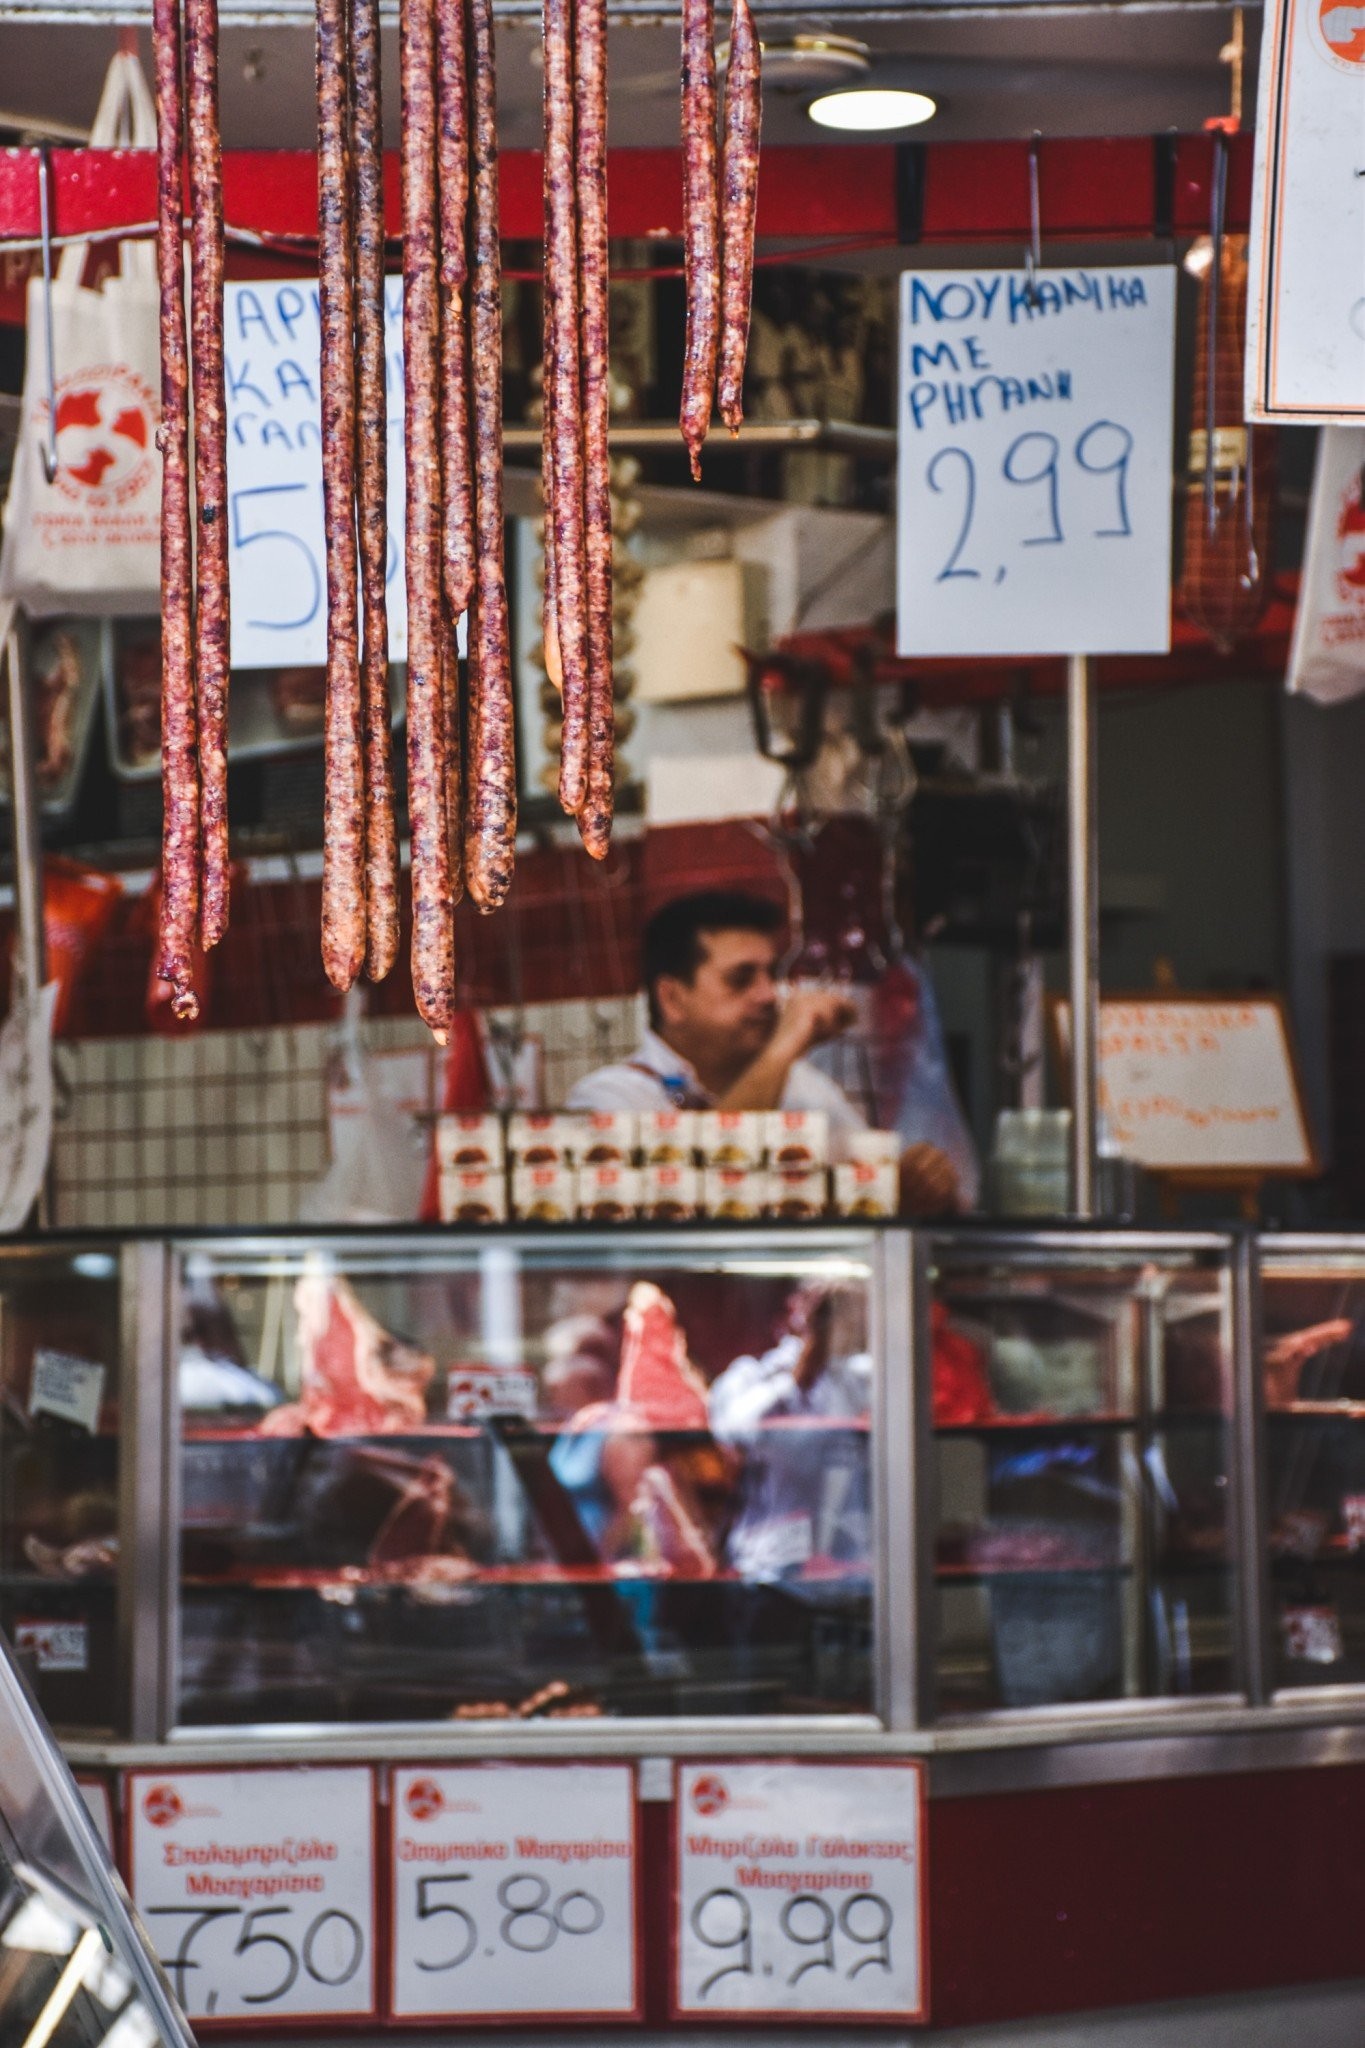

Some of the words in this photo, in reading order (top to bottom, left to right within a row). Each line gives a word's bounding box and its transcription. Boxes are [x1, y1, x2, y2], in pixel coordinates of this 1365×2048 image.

[911, 336, 991, 378] ΜΕ
[926, 419, 1134, 585] 2,99
[145, 1904, 365, 2014] 7,50
[413, 1872, 606, 1974] 5.80
[690, 1887, 895, 2000] 9.99
